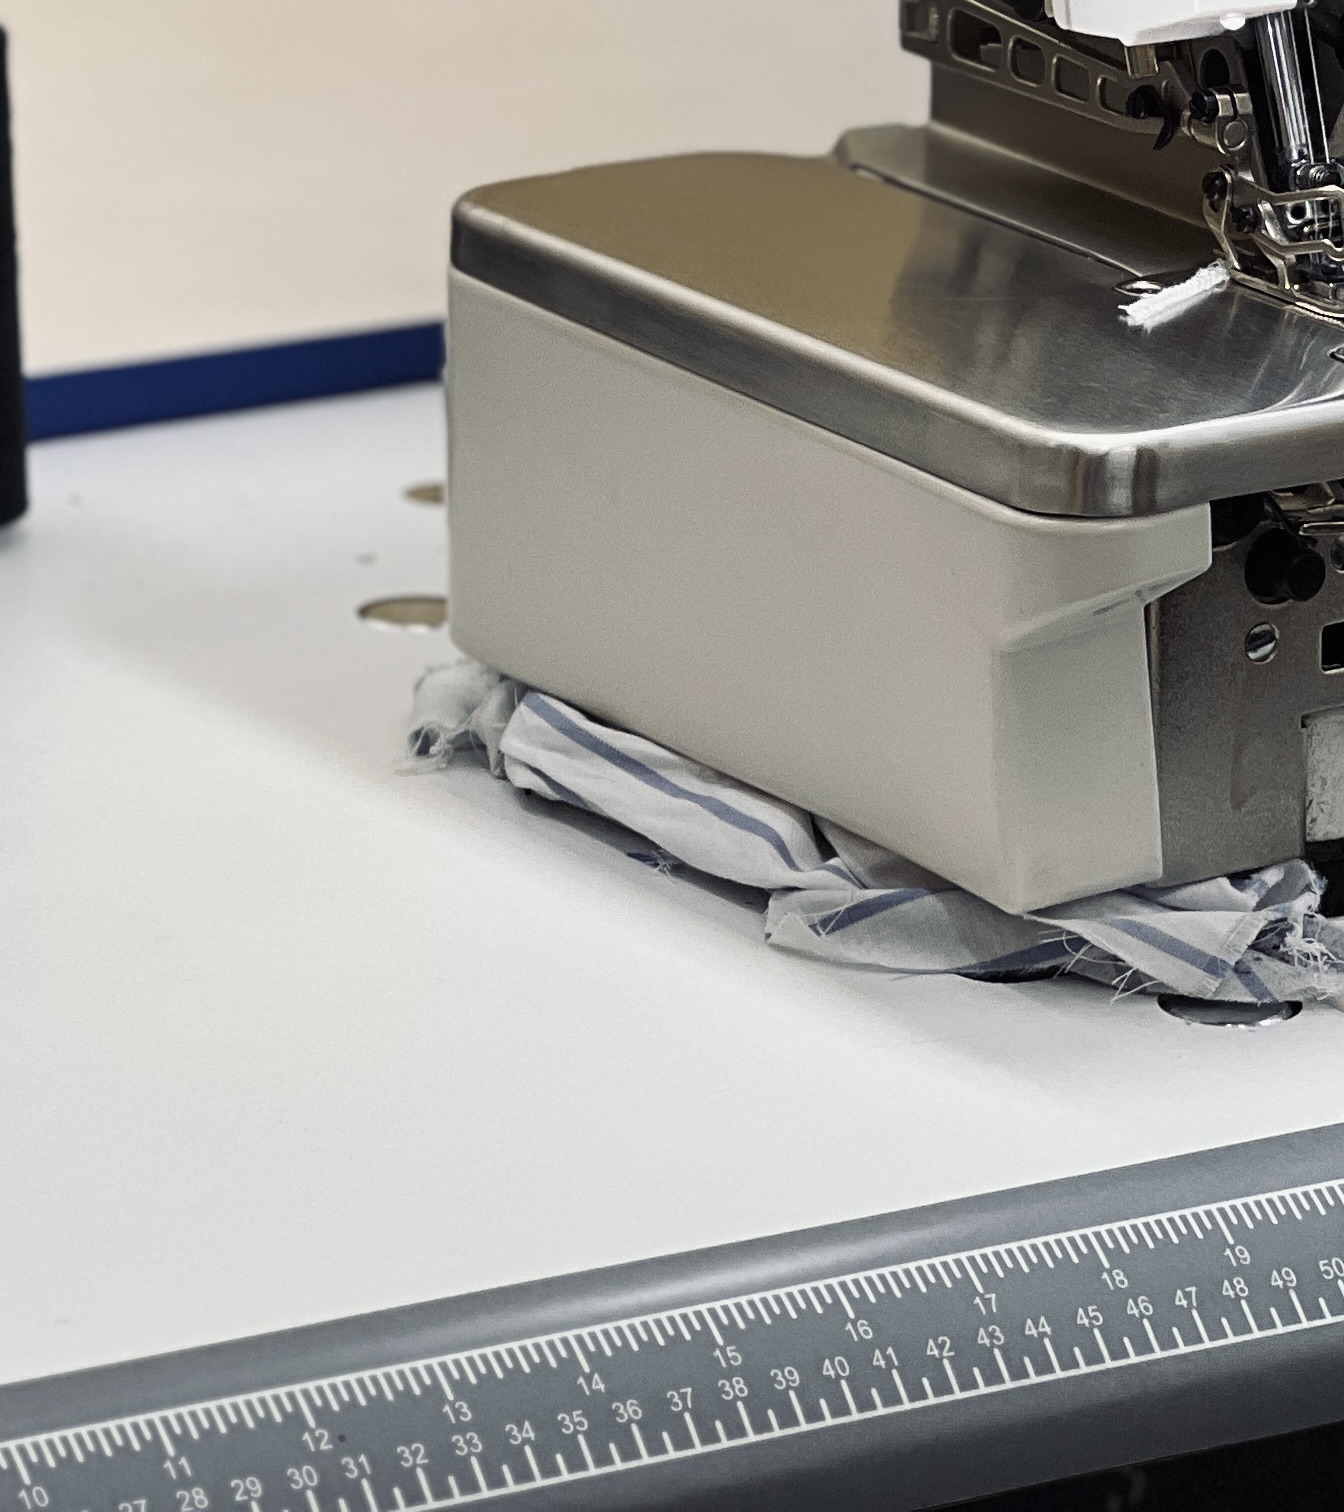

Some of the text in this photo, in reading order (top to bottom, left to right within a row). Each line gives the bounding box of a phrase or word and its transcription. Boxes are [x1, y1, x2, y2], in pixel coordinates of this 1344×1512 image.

[19, 1486, 49, 1509] 10
[164, 1457, 191, 1479] 11
[302, 1429, 332, 1451] 12
[443, 1401, 472, 1423] 13
[577, 1373, 605, 1395] 14
[714, 1346, 742, 1367] 15
[845, 1320, 873, 1341] 16
[974, 1293, 996, 1314] 17
[1102, 1269, 1128, 1289] 18
[1224, 1246, 1250, 1266] 19
[176, 1487, 208, 1512] 28
[231, 1477, 262, 1501] 29
[287, 1465, 318, 1489] 30
[342, 1454, 370, 1478] 31
[397, 1443, 428, 1467] 32
[452, 1432, 482, 1455] 33
[505, 1421, 535, 1444] 34
[557, 1410, 588, 1434] 35
[612, 1399, 642, 1422] 36
[667, 1387, 692, 1411] 37
[718, 1377, 748, 1400] 38
[770, 1367, 800, 1389] 39
[823, 1356, 849, 1378] 40
[873, 1347, 898, 1368] 41
[927, 1336, 954, 1357] 42
[978, 1325, 1004, 1346] 43
[1025, 1316, 1051, 1337] 44
[1077, 1306, 1103, 1326] 45
[1127, 1296, 1153, 1317] 46
[1175, 1287, 1196, 1307] 47
[1223, 1277, 1248, 1298] 48
[1271, 1267, 1296, 1288] 49
